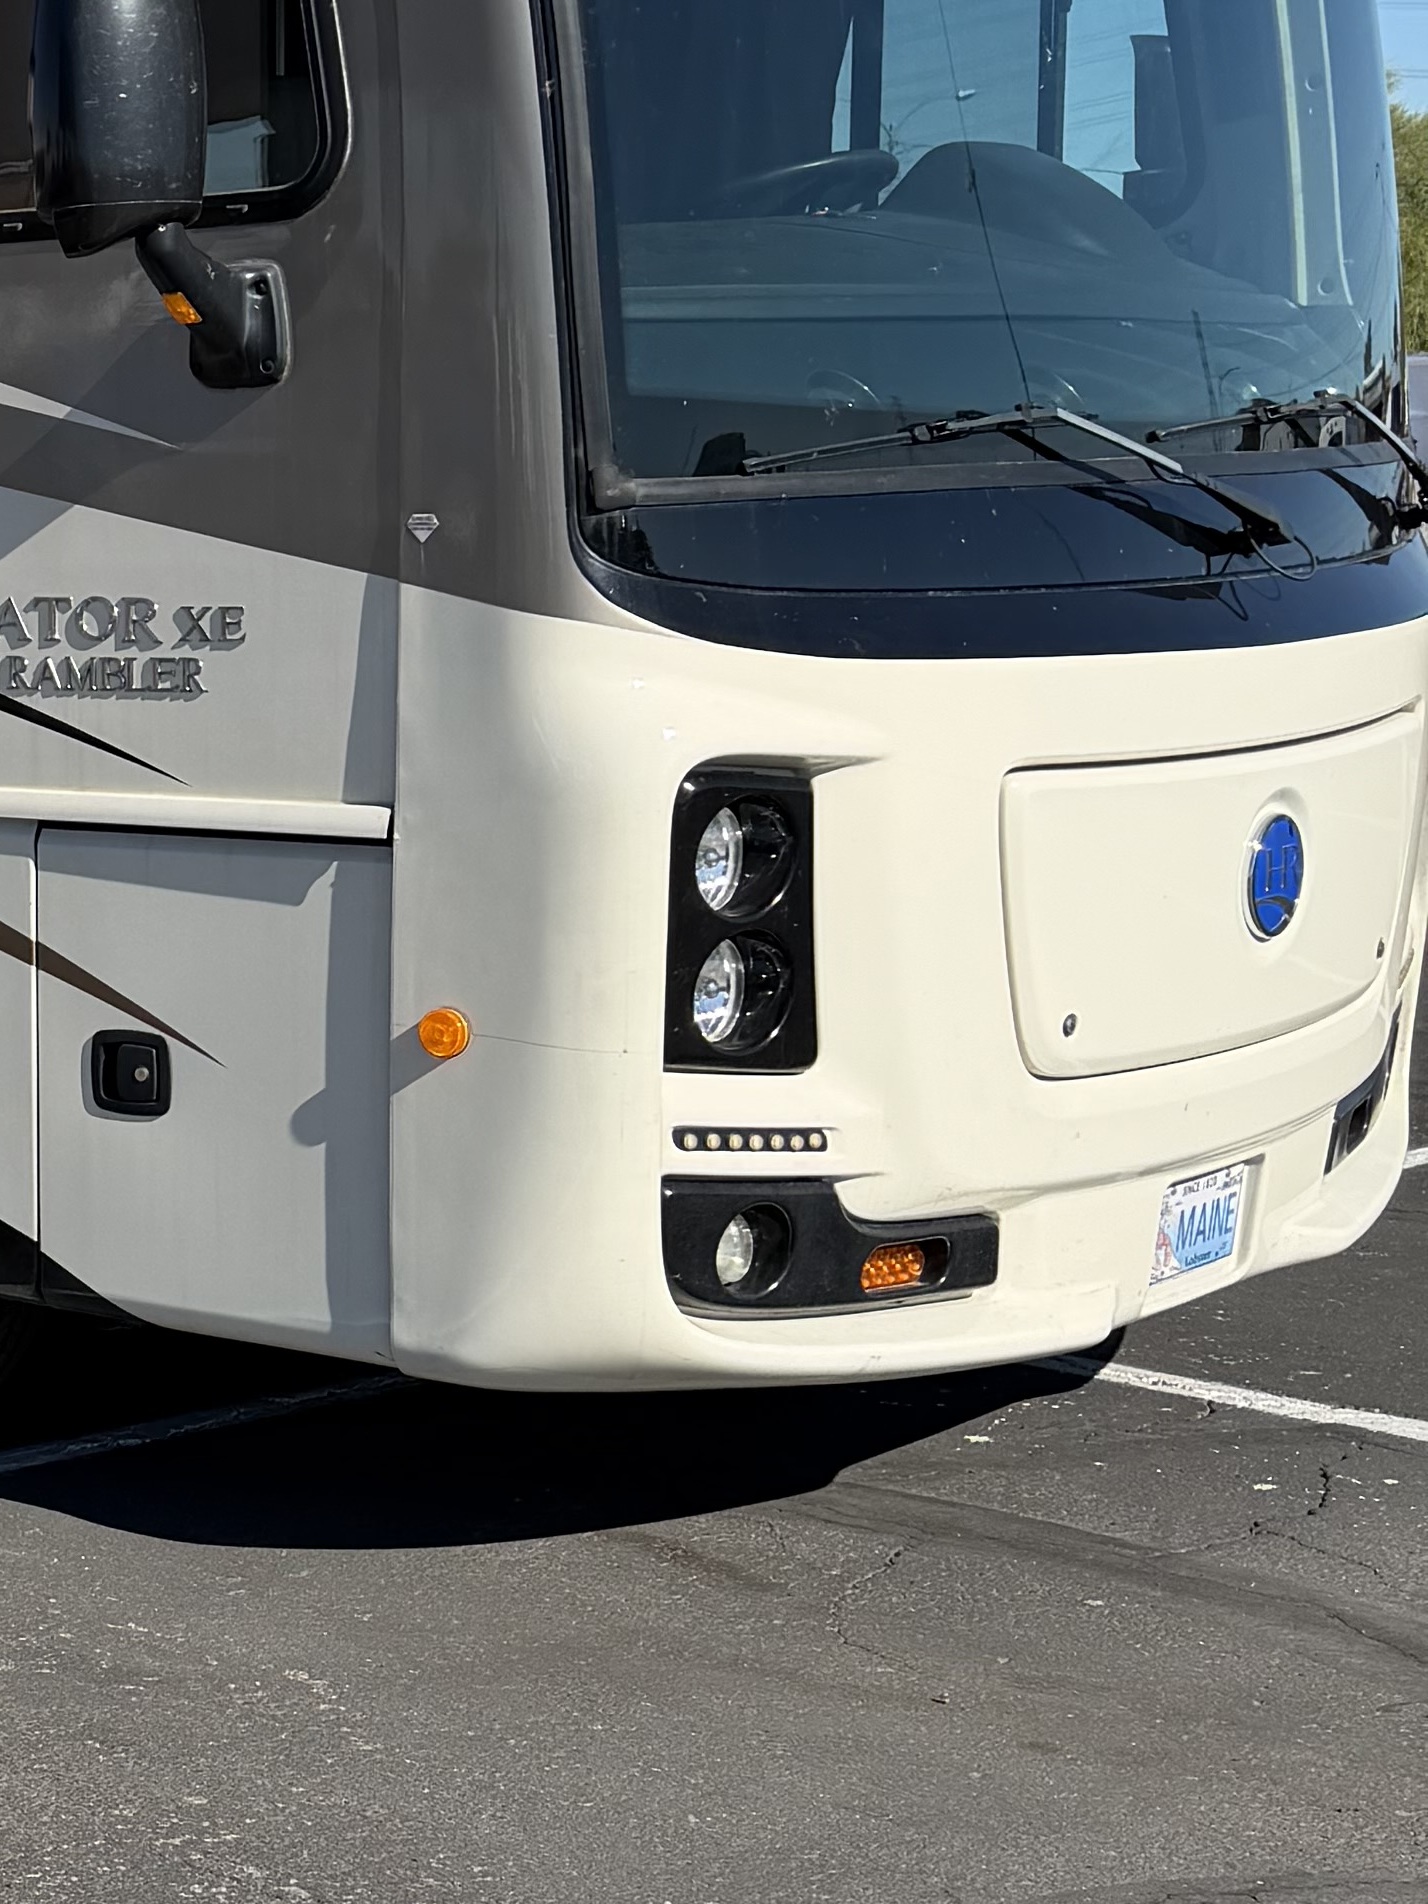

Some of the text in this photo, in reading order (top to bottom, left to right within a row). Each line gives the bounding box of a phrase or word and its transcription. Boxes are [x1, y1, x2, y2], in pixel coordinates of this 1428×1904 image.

[177, 605, 246, 643] XE
[5, 655, 209, 694] RAMBLER
[1175, 1191, 1238, 1253] MAINE
